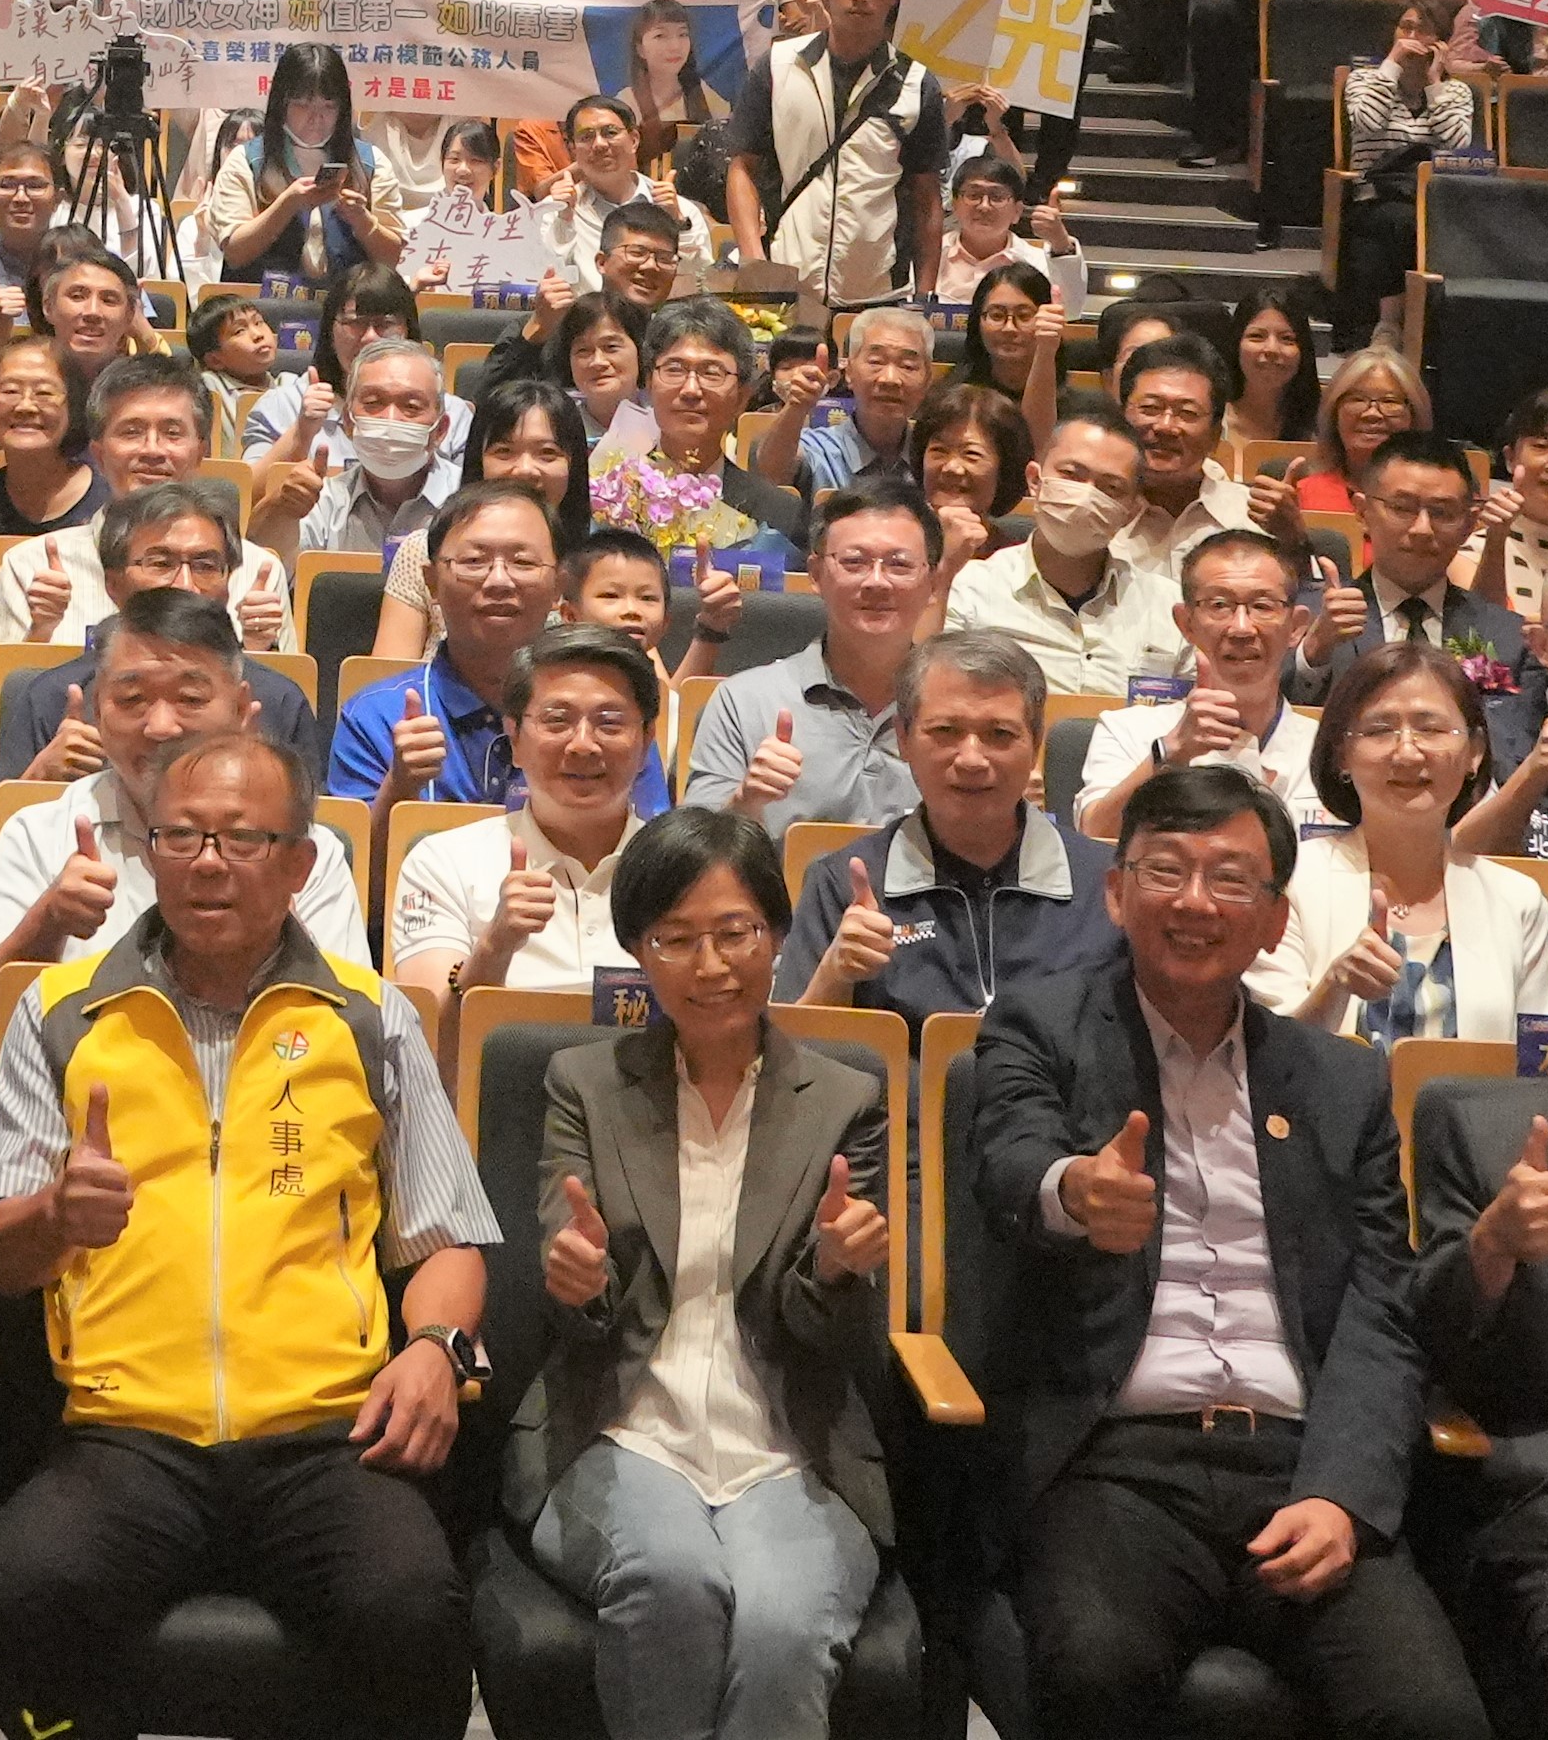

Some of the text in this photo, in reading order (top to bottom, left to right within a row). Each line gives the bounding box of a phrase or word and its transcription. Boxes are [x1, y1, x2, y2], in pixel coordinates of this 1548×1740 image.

[17, 1, 135, 41] 讓孩子
[267, 1079, 309, 1200] 人事處
